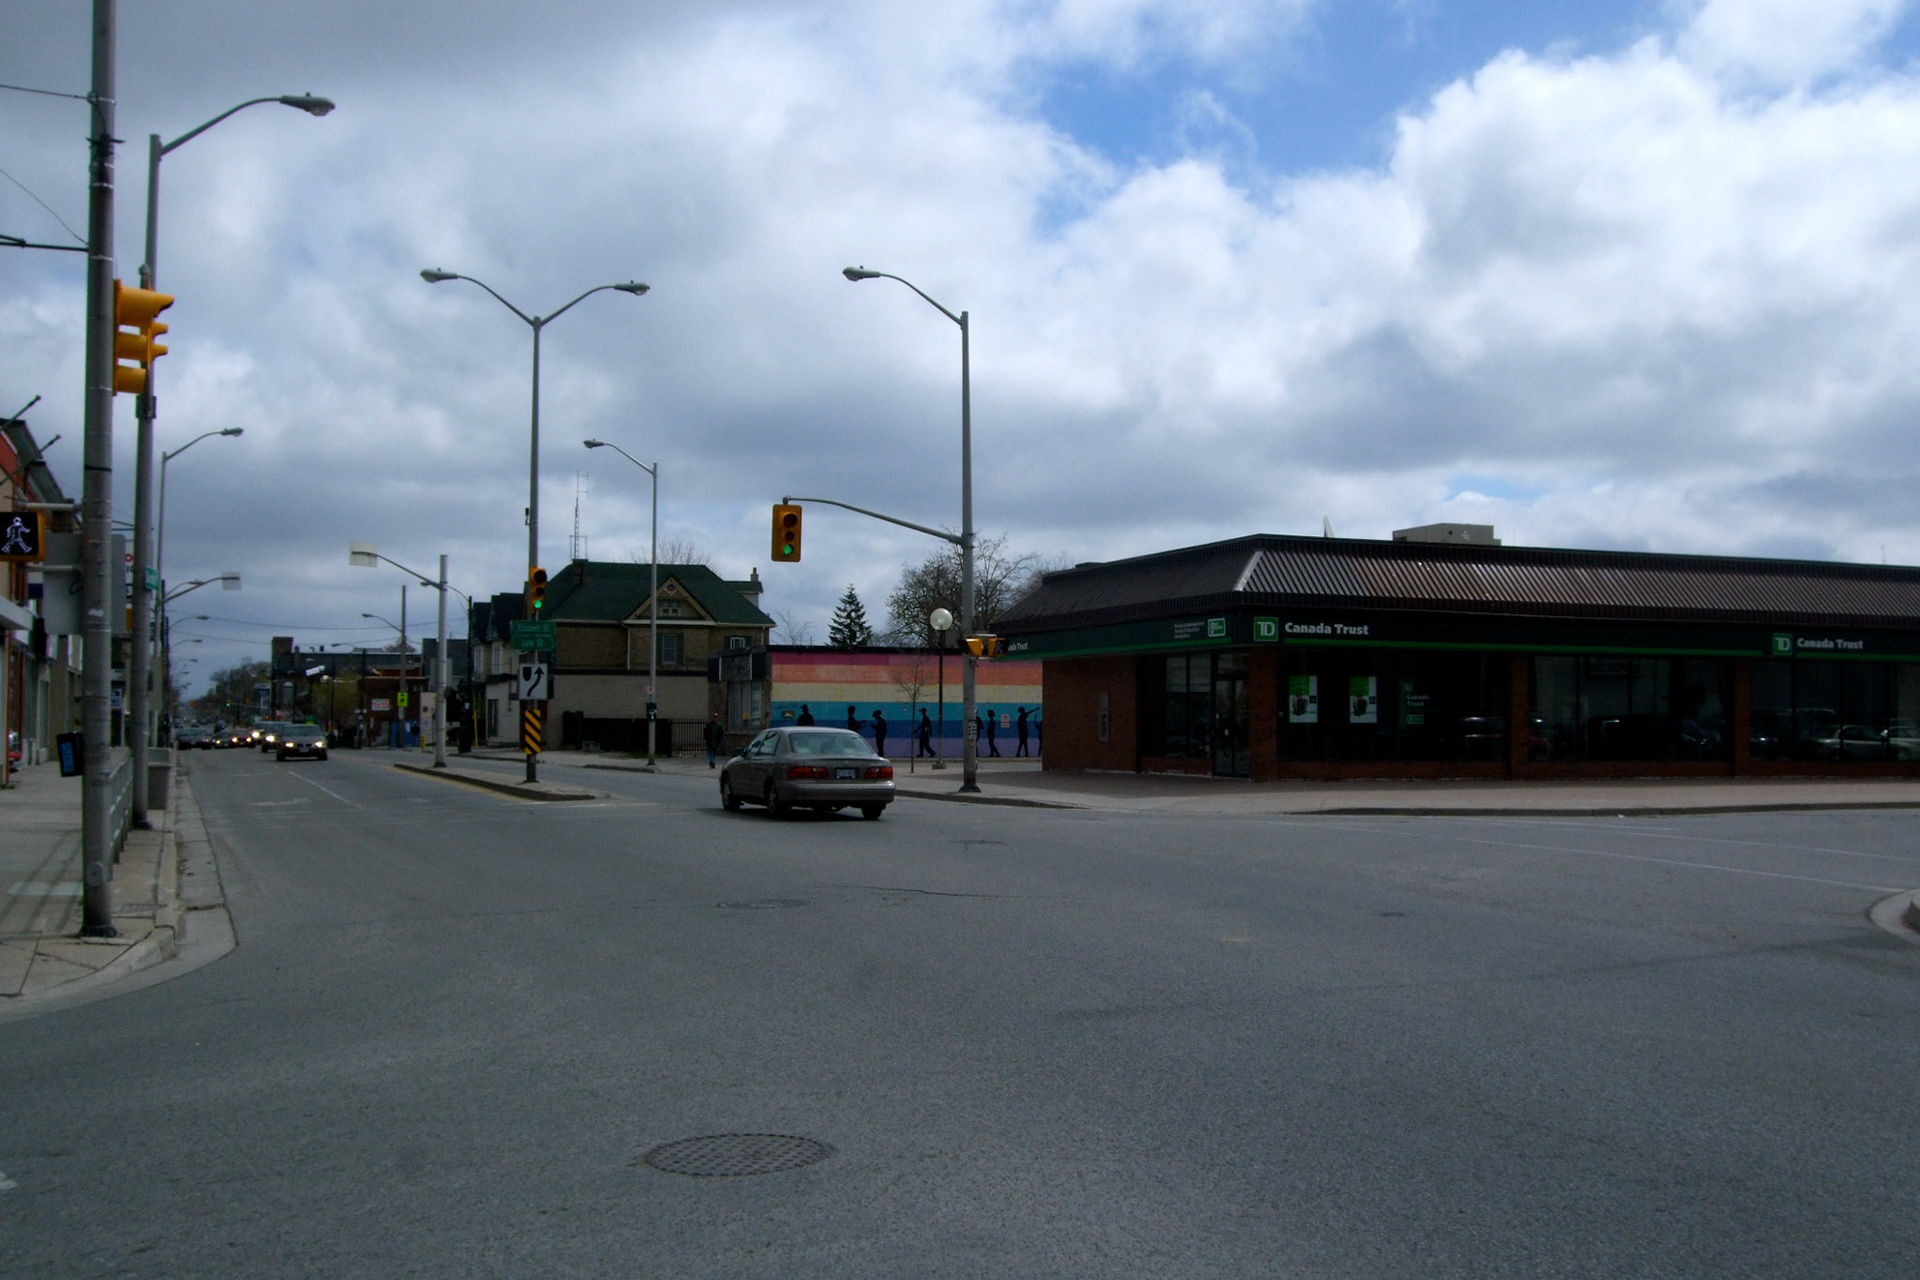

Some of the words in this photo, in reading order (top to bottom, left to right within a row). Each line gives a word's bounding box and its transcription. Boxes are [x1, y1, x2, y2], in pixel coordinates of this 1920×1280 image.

[1257, 621, 1276, 637] TD
[1284, 622, 1332, 634] Canada
[1334, 623, 1370, 636] Trust
[1775, 637, 1791, 651] TD
[1796, 637, 1835, 649] Canada
[1835, 638, 1864, 650] Trust
